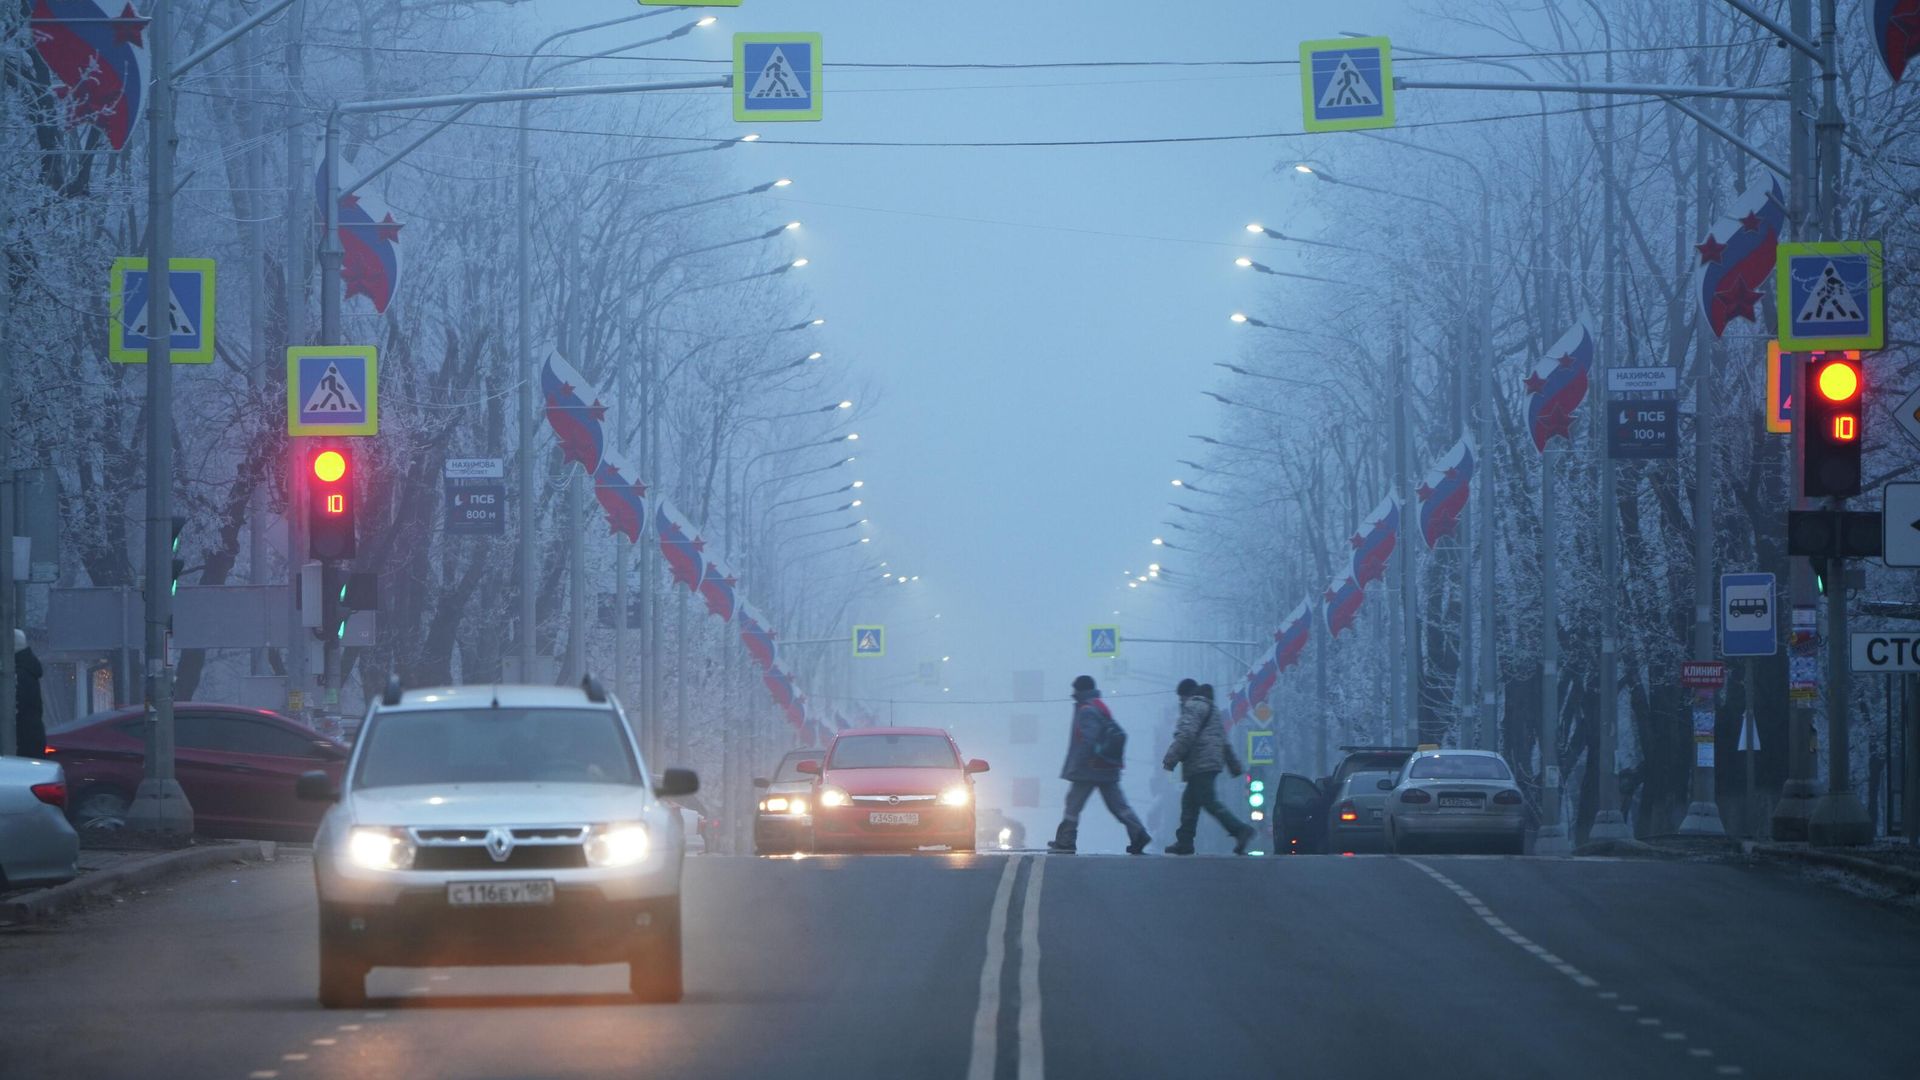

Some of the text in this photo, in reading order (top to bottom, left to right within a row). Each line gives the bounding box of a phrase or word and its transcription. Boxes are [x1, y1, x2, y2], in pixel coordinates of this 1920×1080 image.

[1616, 371, 1666, 380] НАХИМОВА
[1637, 411, 1666, 422] ПСБ
[1835, 416, 1853, 439] 10
[1633, 429, 1666, 440] 100 м
[451, 461, 496, 469] НАХИМОВА
[327, 494, 343, 513] 10
[470, 494, 496, 504] ПСБ
[466, 510, 496, 520] 800 м
[1684, 665, 1723, 677] КЛИНИНГ
